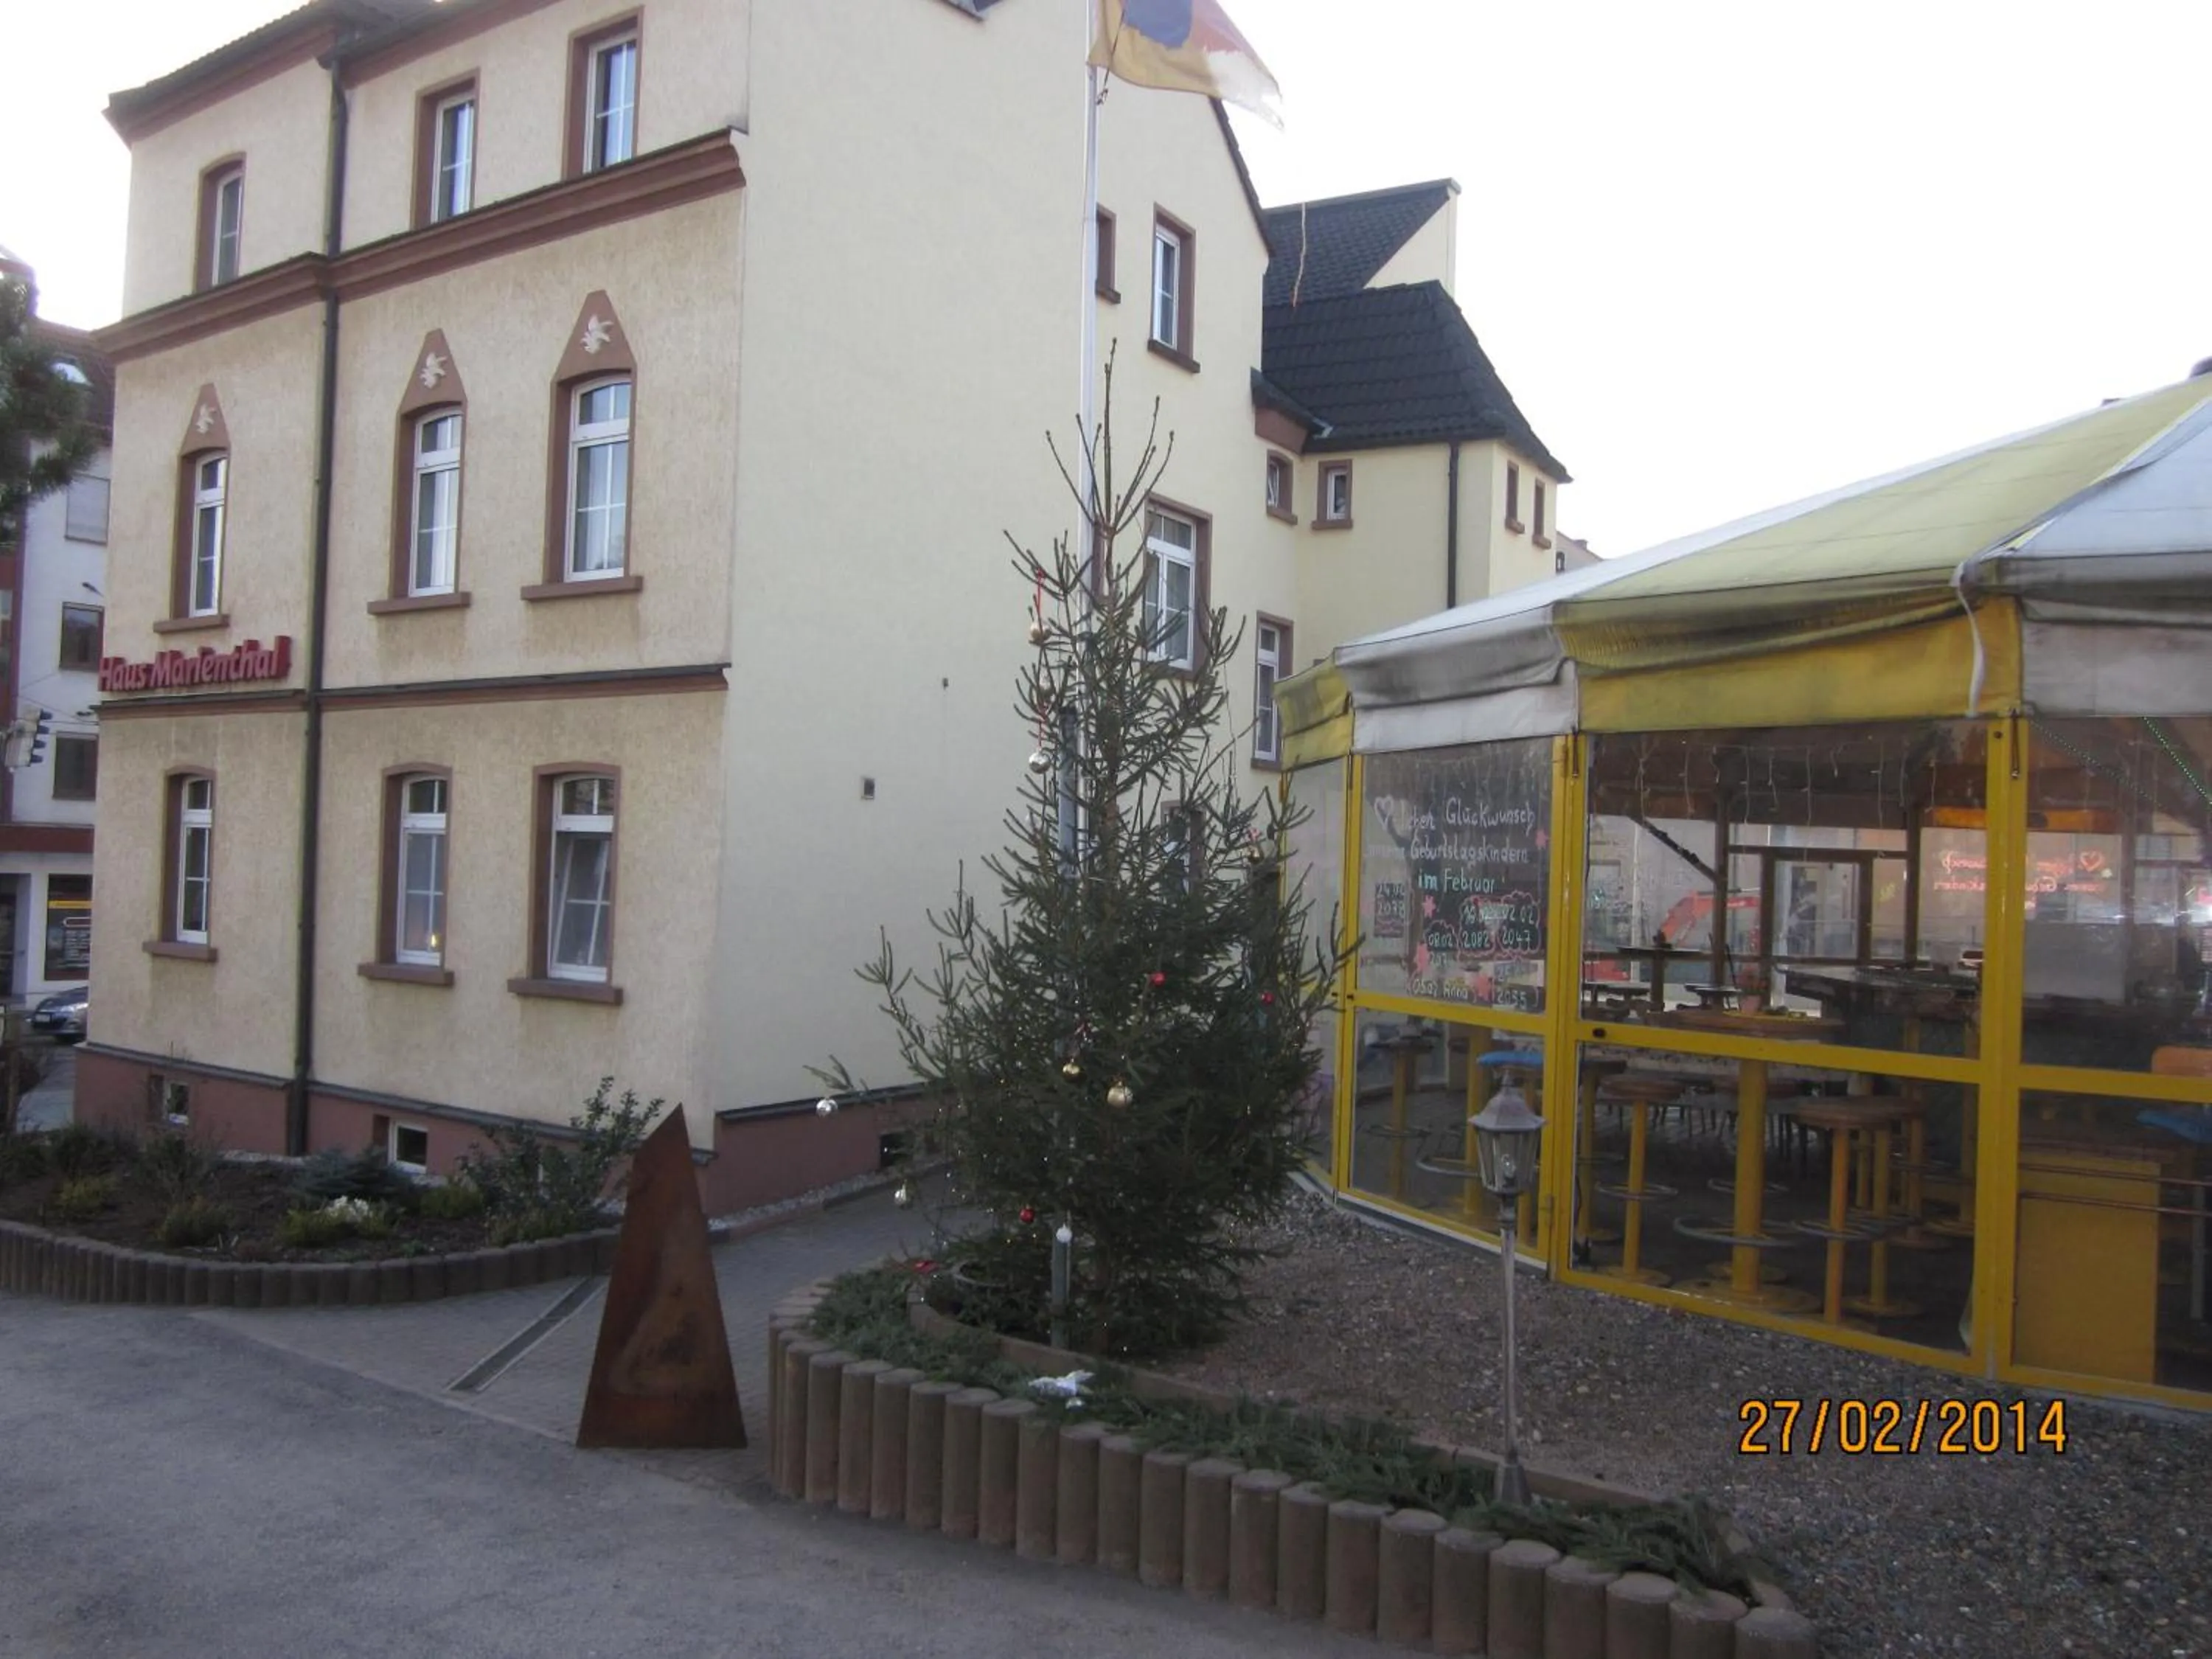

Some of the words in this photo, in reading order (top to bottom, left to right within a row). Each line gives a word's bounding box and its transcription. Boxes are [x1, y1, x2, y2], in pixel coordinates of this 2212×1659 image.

[98, 657, 149, 692] Haus
[150, 636, 292, 687] Marienthal
[1445, 796, 1535, 836] Glückwunsch
[1419, 871, 1437, 891] im
[1443, 867, 1495, 894] Februar
